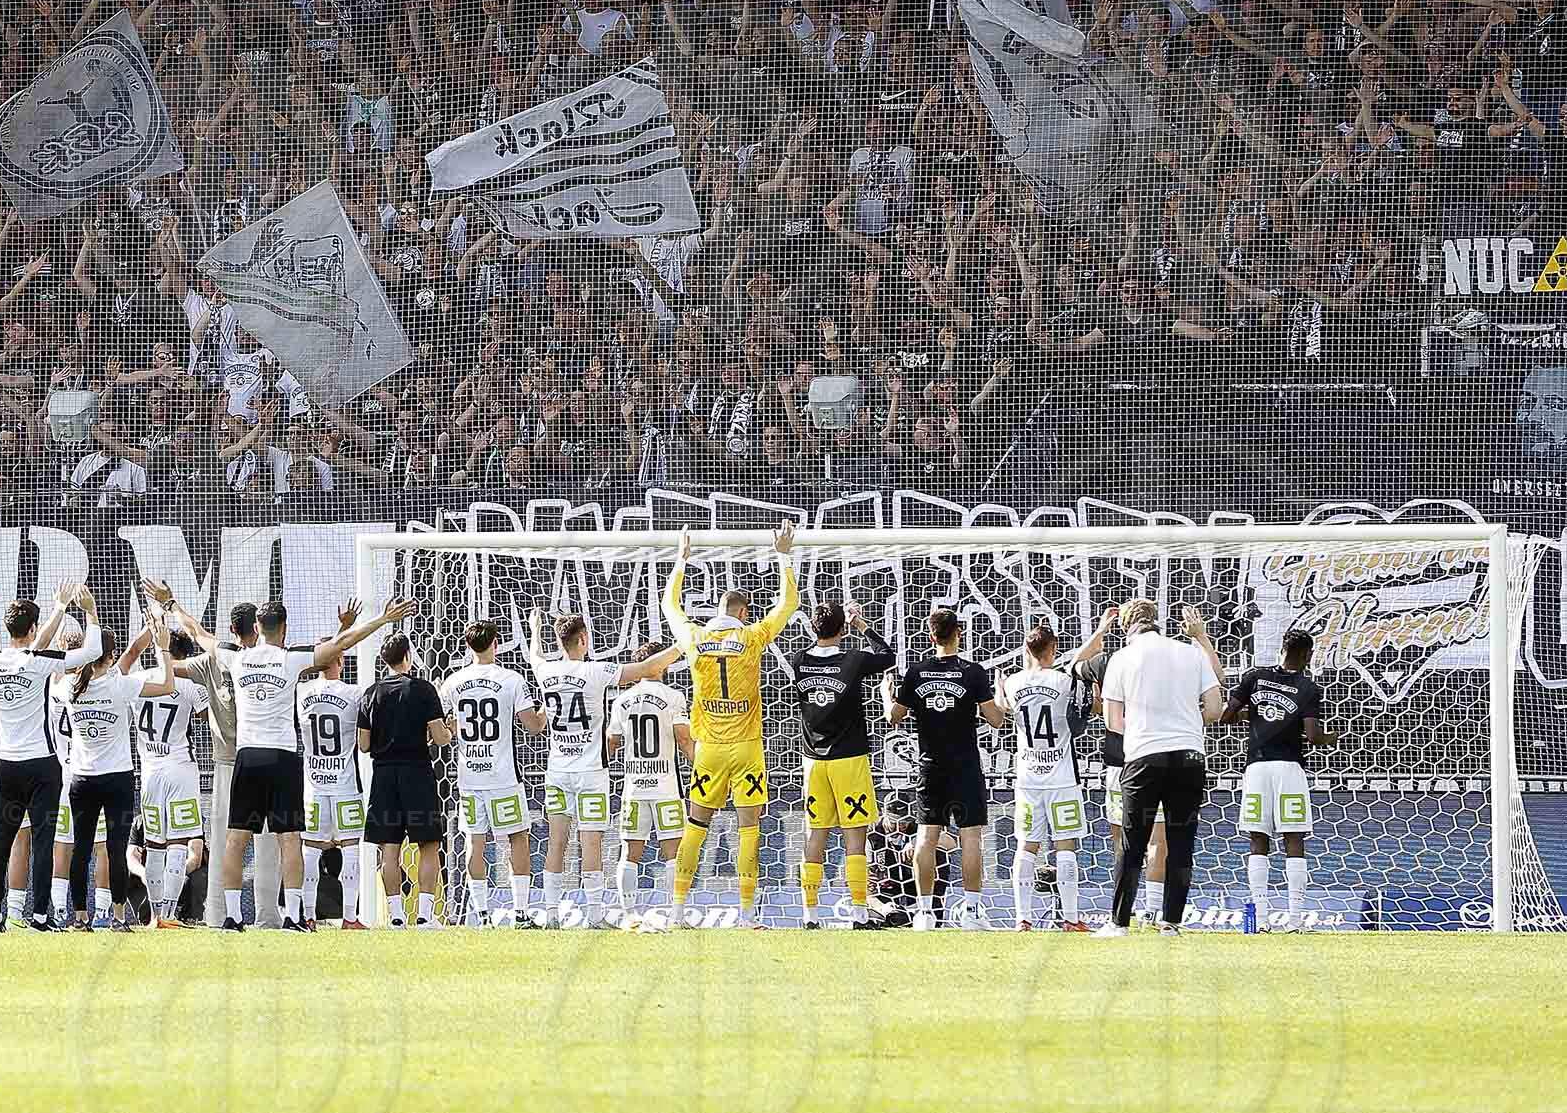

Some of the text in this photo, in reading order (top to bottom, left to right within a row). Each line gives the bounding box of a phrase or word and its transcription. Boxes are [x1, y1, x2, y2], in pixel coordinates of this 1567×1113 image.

[239, 674, 287, 689] PUNTIGAMER
[715, 657, 728, 700] 1
[796, 676, 847, 694] PUNTIGAMER
[915, 681, 967, 698] PUNTIGAMER
[138, 700, 179, 743] 47
[302, 694, 349, 710] PUNTIGAMER
[457, 697, 501, 742] 38
[544, 691, 593, 732] 24
[703, 698, 750, 714] SCHERPEN
[307, 713, 342, 757] 19
[627, 713, 660, 759] 10
[1019, 704, 1058, 748] 14
[466, 760, 493, 772] Grapos
